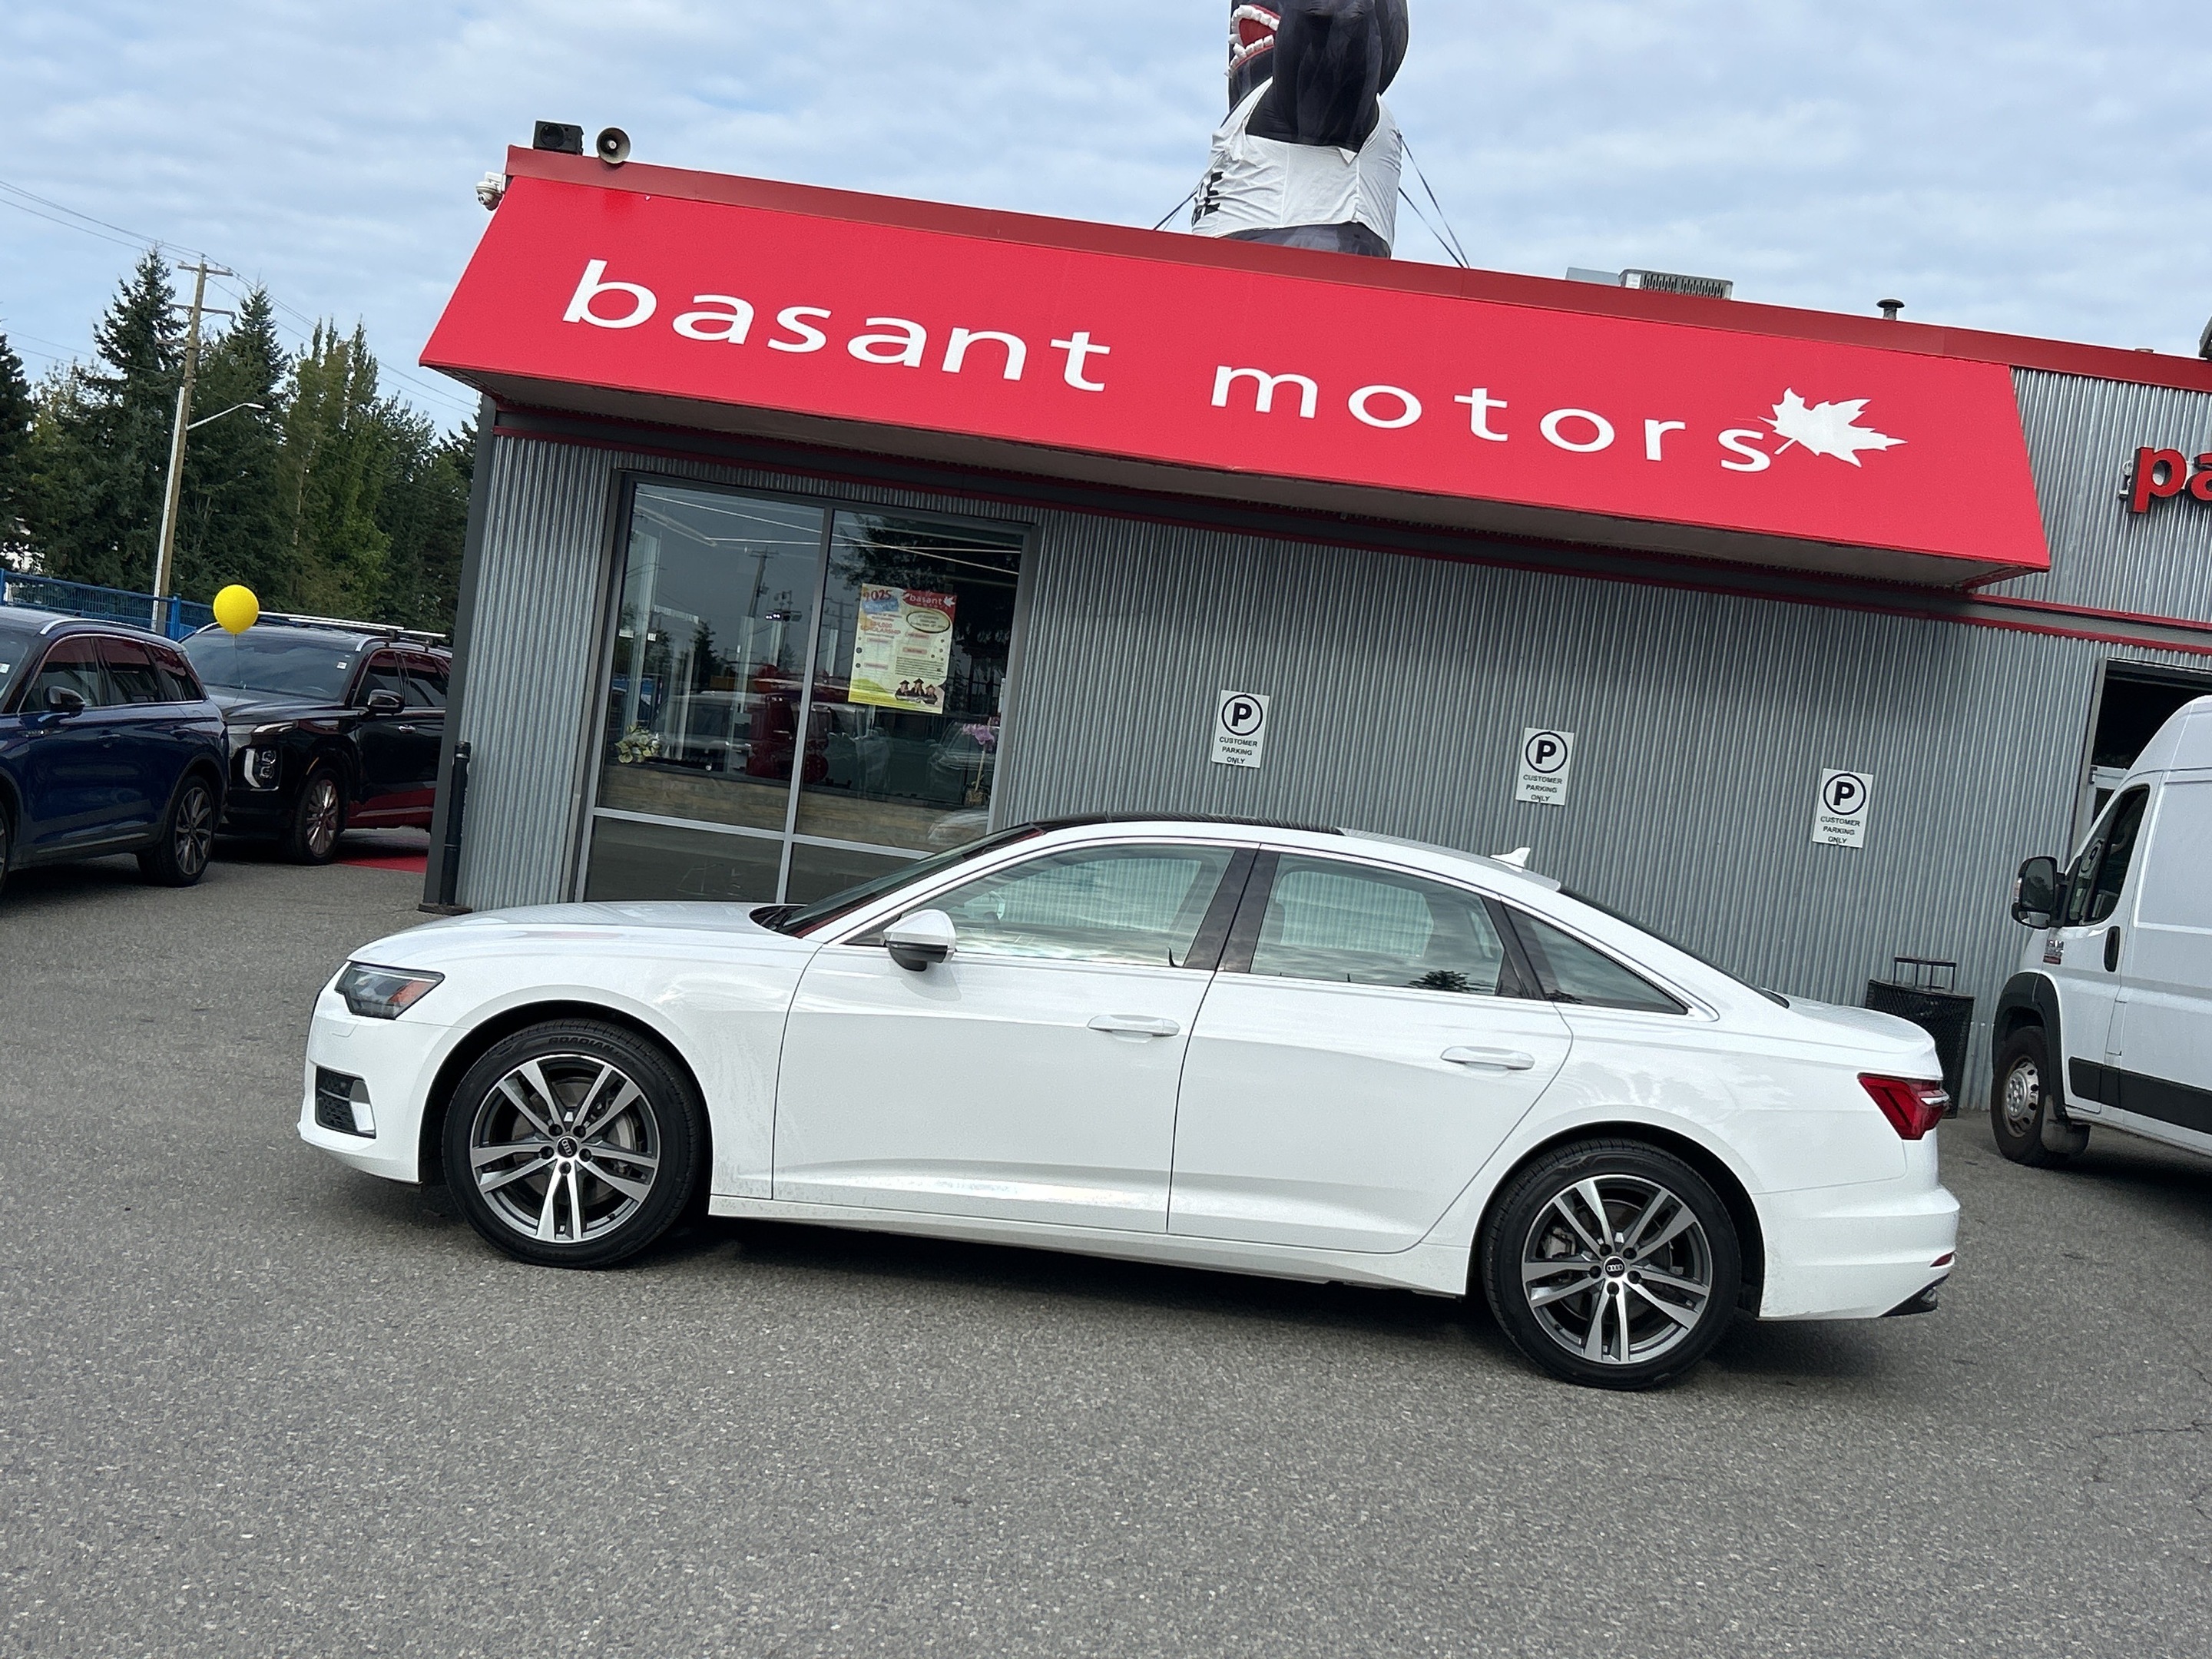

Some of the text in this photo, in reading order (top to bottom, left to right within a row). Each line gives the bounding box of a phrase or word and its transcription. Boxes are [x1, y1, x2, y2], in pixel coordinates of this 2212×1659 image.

[563, 260, 1770, 471] basant motors
[909, 594, 942, 605] basant
[1231, 702, 1253, 727] P
[1219, 736, 1258, 747] CUSTOMER
[1222, 746, 1253, 756] PARKING
[1535, 740, 1557, 764] P
[1227, 756, 1246, 764] ONLY
[1523, 774, 1563, 784] CUSTOMER
[1525, 784, 1558, 793] PARKING
[1833, 780, 1855, 806] P
[1820, 816, 1861, 826] CUSTOMER
[1823, 826, 1855, 836] PARKING
[1828, 836, 1847, 844] ONLY
